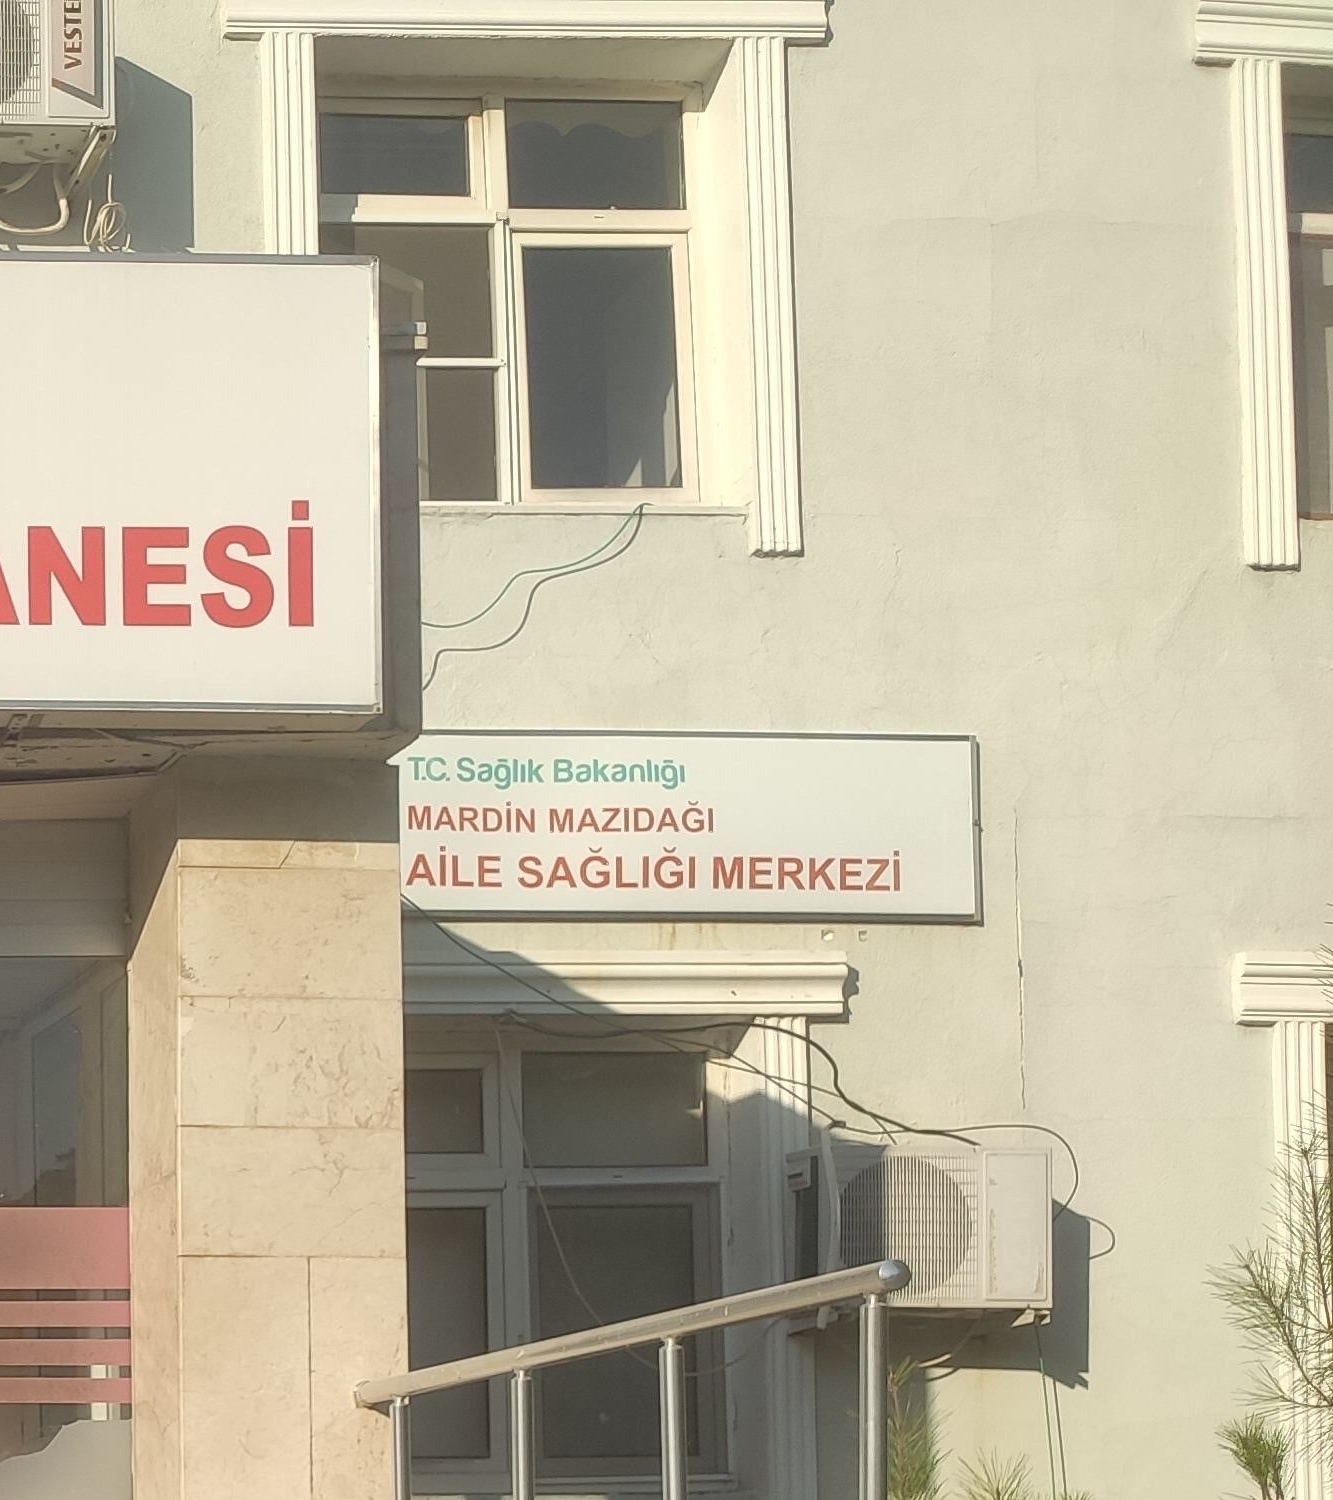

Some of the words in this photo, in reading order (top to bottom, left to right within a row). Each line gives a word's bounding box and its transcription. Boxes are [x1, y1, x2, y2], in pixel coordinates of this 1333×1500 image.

[64, 0, 82, 69] VESTE
[407, 756, 451, 783] T.C.
[456, 756, 545, 790] Sağlık
[553, 757, 686, 791] Bakanlığı
[407, 801, 536, 833] MARDİN
[548, 801, 715, 835] MAZIDAĞI
[405, 846, 503, 890] AİLE
[517, 847, 698, 892] SAĞLIĞI
[713, 850, 902, 893] MERKEZİ
